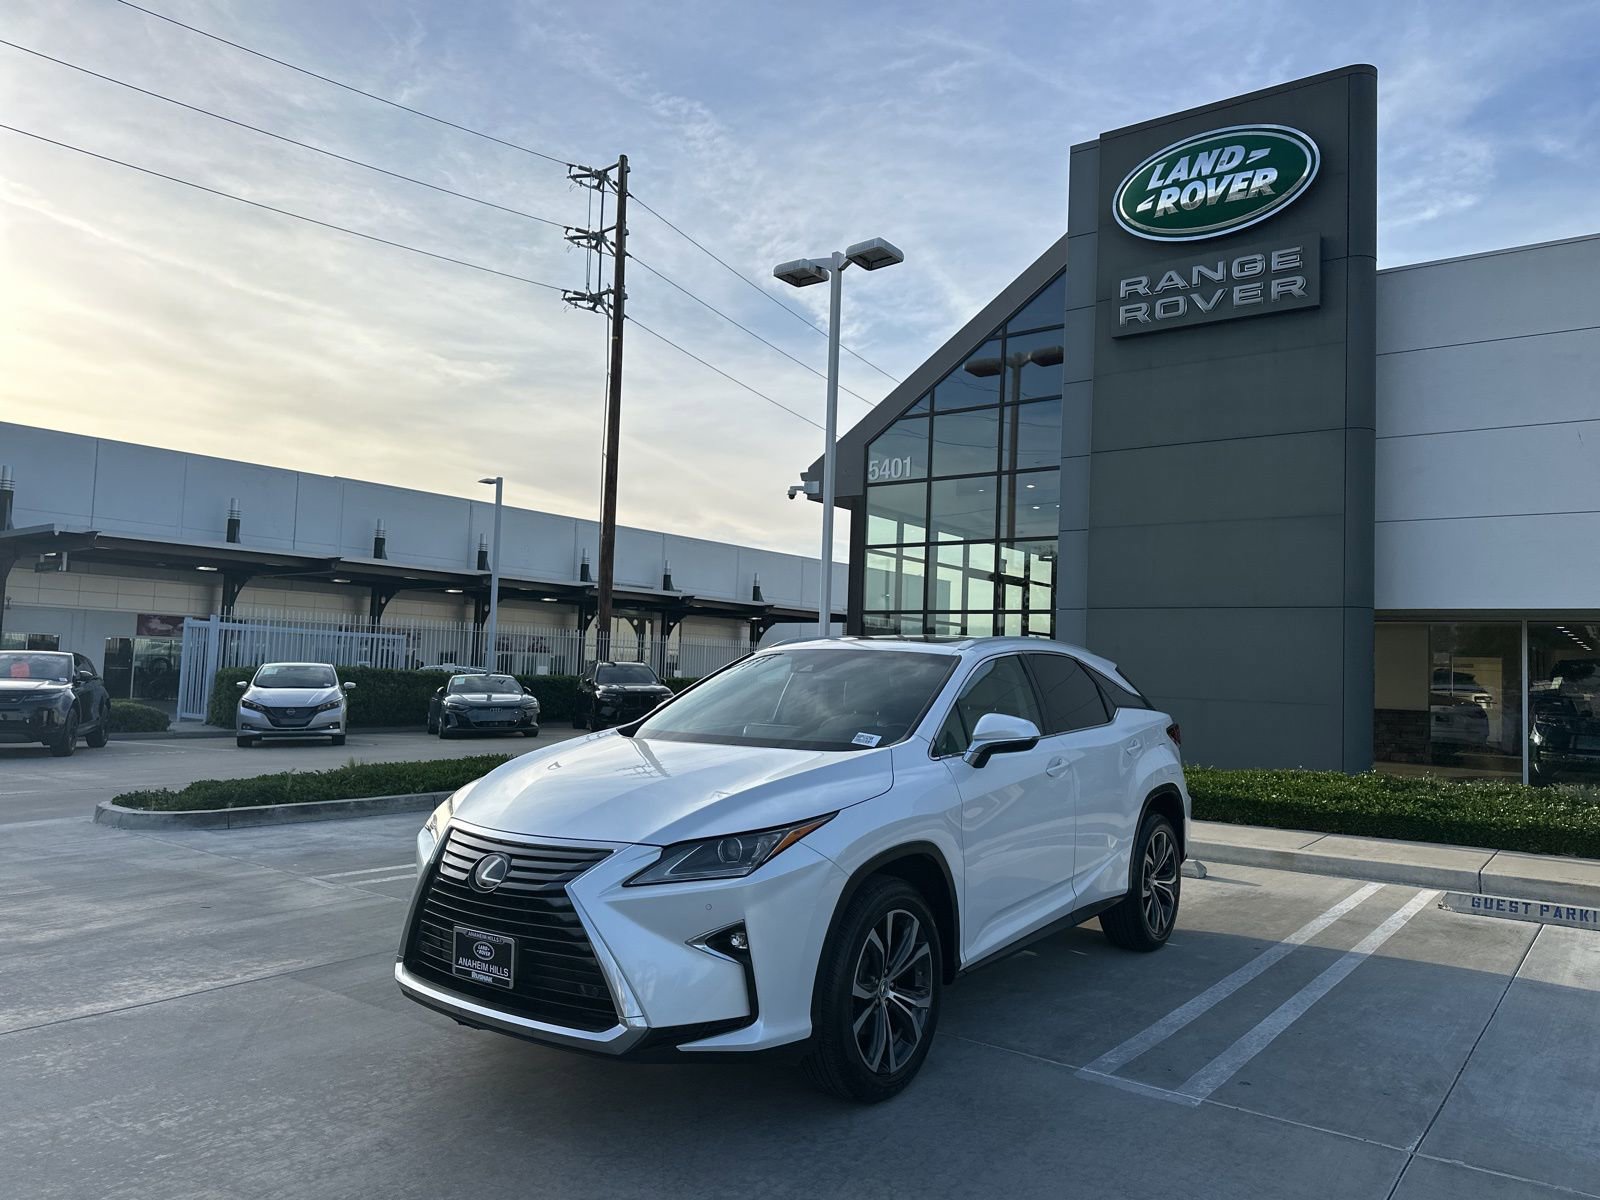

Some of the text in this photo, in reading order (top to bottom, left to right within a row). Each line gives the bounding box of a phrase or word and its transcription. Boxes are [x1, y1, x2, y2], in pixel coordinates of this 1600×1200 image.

[1146, 144, 1246, 191] LAND
[1153, 167, 1278, 218] ROVER
[1119, 246, 1304, 299] RANGE
[1119, 275, 1308, 327] ROVER
[869, 456, 911, 480] 5401
[1472, 897, 1531, 914] GUEST
[458, 956, 509, 977] ANAHEIM HILLS
[478, 949, 491, 957] ROVER
